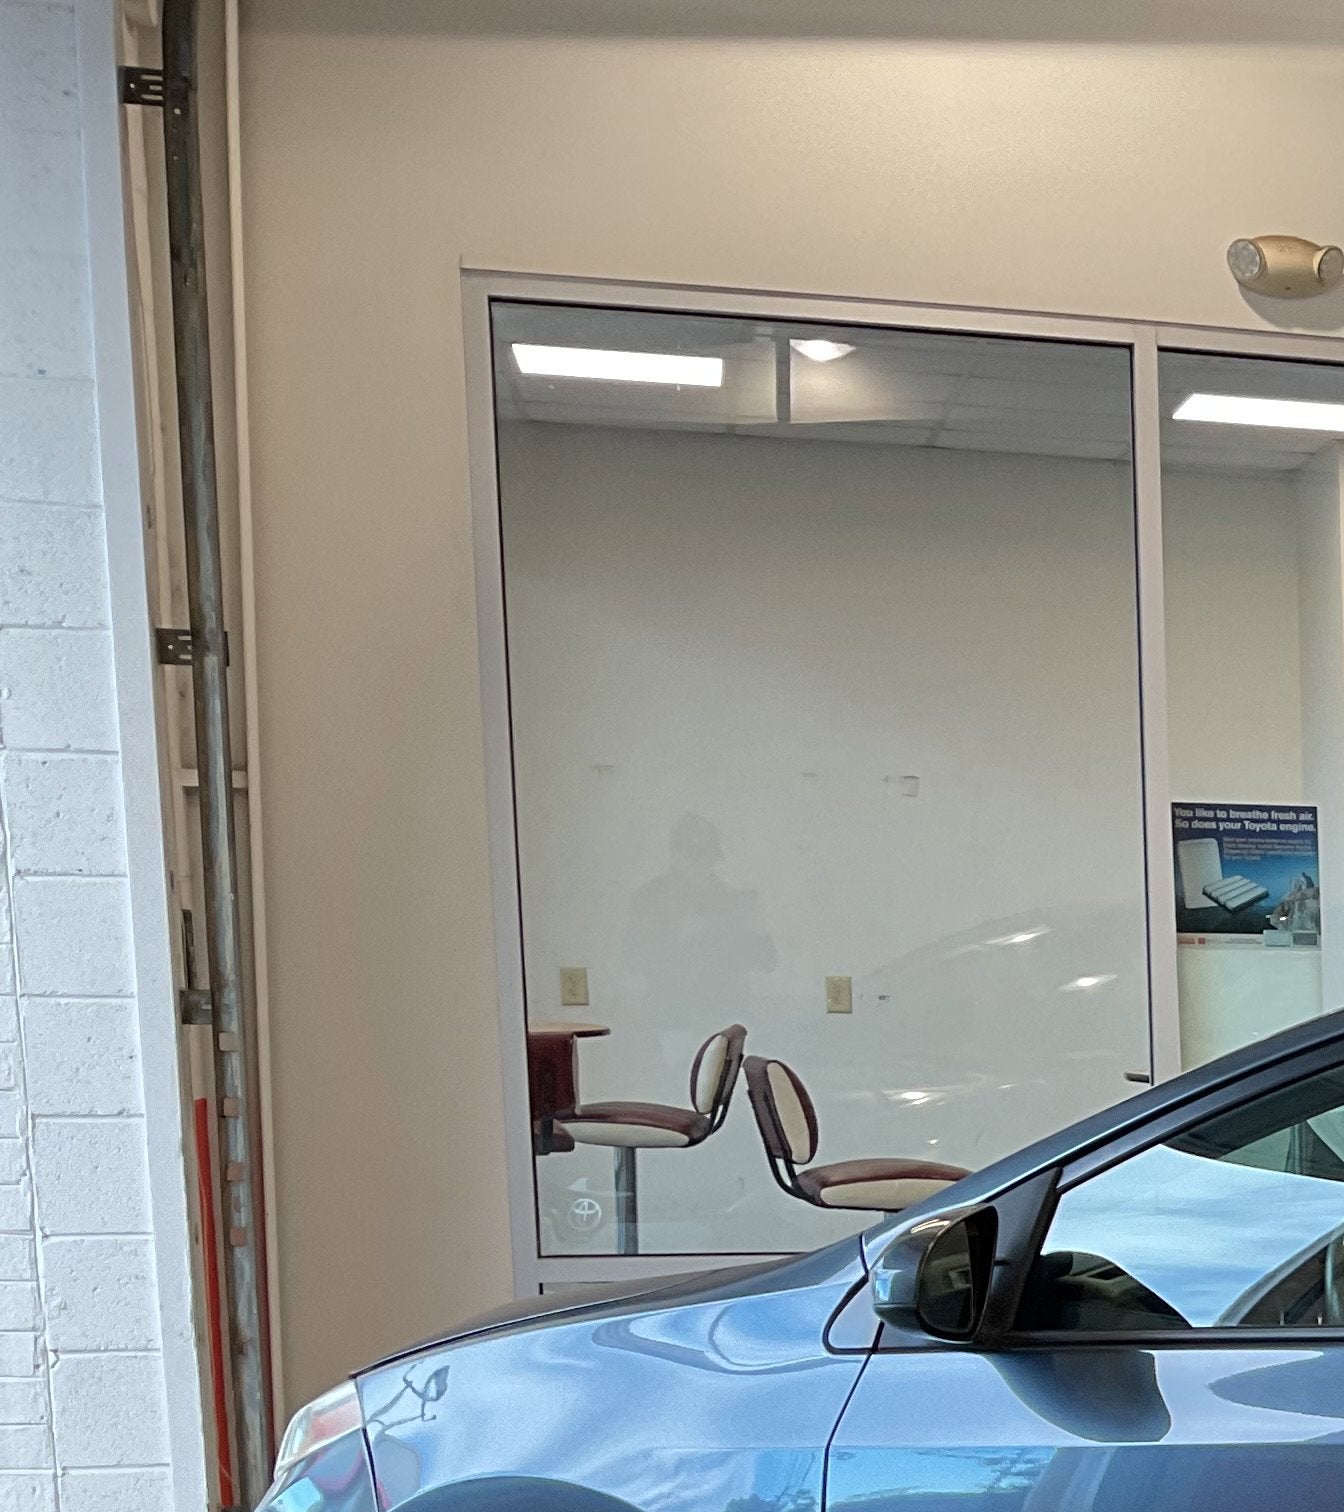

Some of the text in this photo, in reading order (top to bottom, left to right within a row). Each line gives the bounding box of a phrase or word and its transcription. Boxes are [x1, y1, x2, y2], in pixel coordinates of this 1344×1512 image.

[1174, 807, 1193, 817] You
[1195, 808, 1214, 818] like
[1216, 809, 1228, 819] to
[1229, 808, 1269, 820] breathe
[1271, 810, 1297, 820] fresh
[1175, 819, 1317, 834] So does your Toyota engine.
